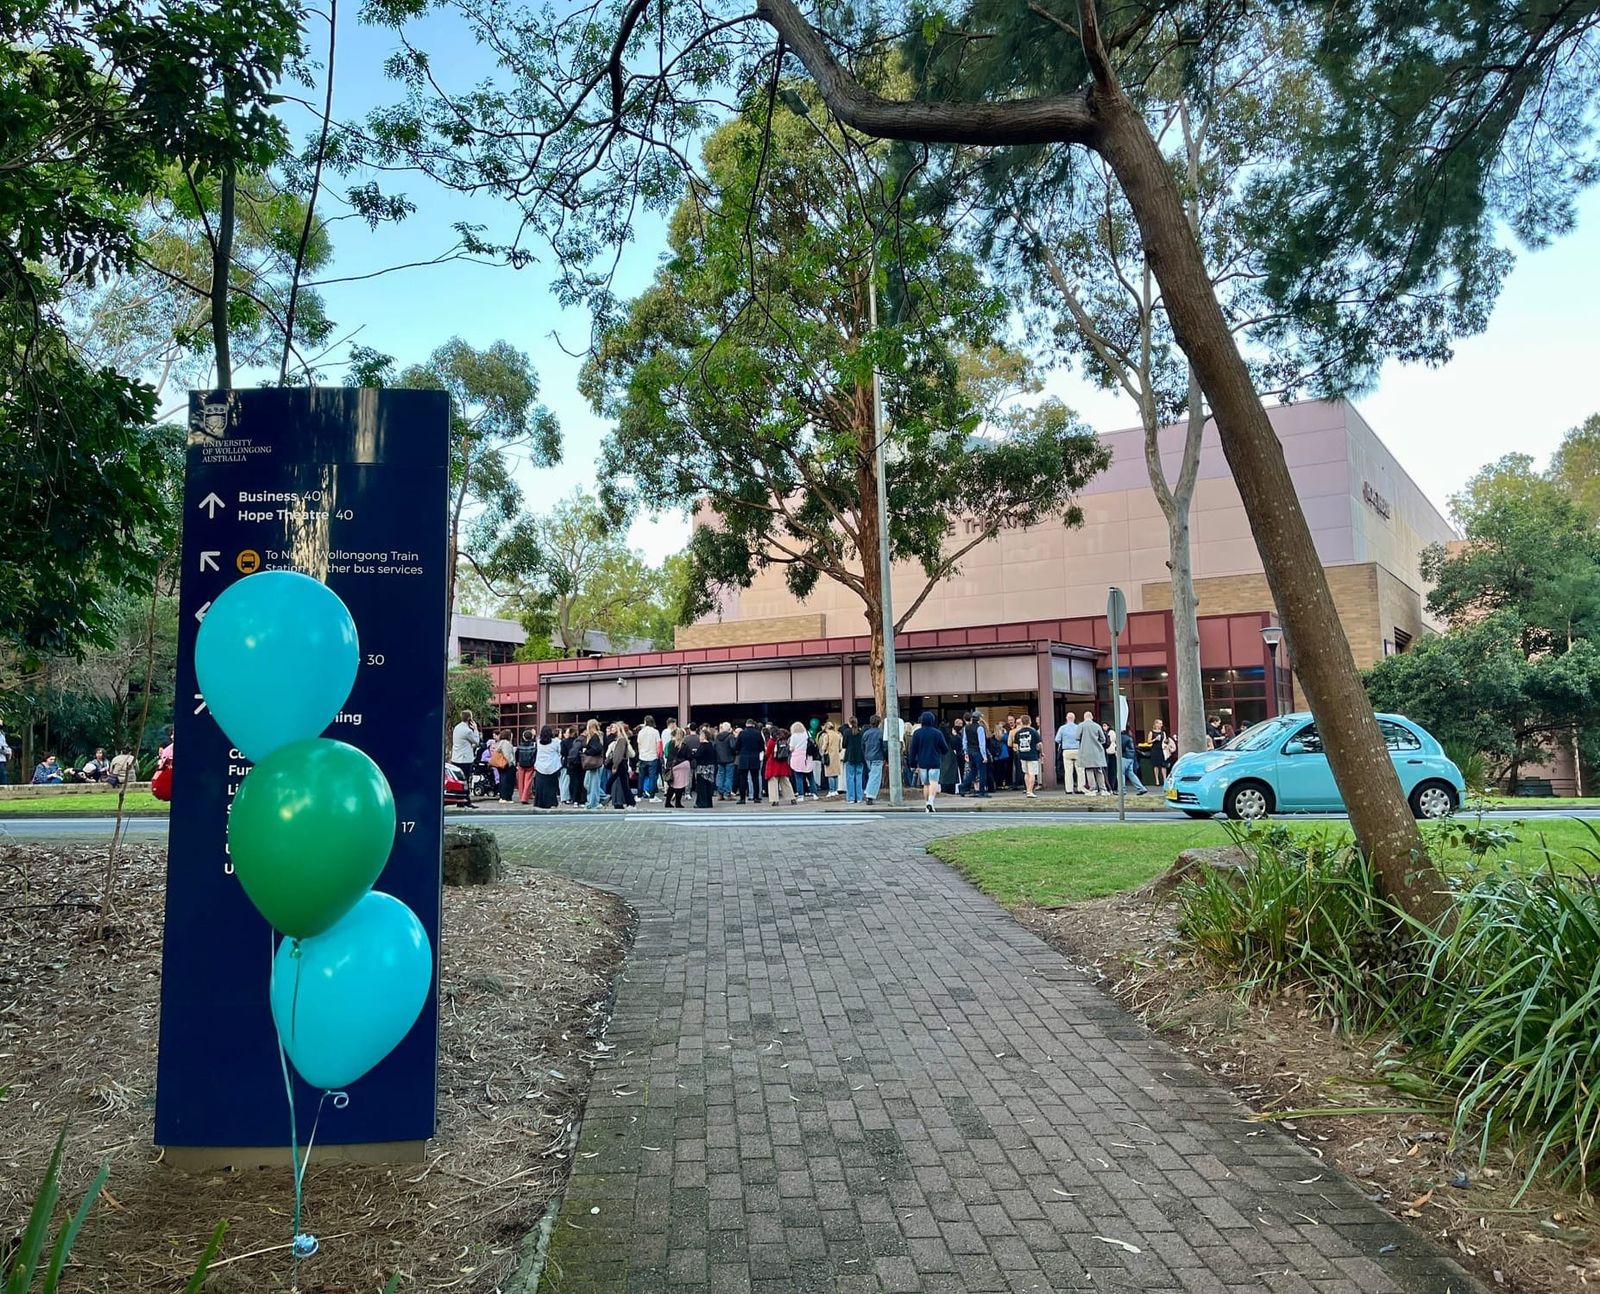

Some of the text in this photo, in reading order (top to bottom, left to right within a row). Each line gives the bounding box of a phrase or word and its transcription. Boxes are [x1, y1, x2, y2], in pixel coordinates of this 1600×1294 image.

[203, 439, 252, 448] UNIVERSITY
[202, 446, 272, 455] OF WOLLONGONG
[202, 454, 247, 463] AUSTRALIA
[238, 490, 321, 502] Business 40
[238, 509, 354, 523] Hope Theatre 40
[265, 550, 279, 560] To
[317, 549, 388, 563] Wollongong
[390, 551, 419, 561] Train
[265, 563, 305, 573] Station
[324, 563, 351, 574] ther
[353, 563, 375, 574] bus
[377, 564, 423, 575] services
[366, 654, 385, 665] 30
[401, 821, 416, 833] 17
